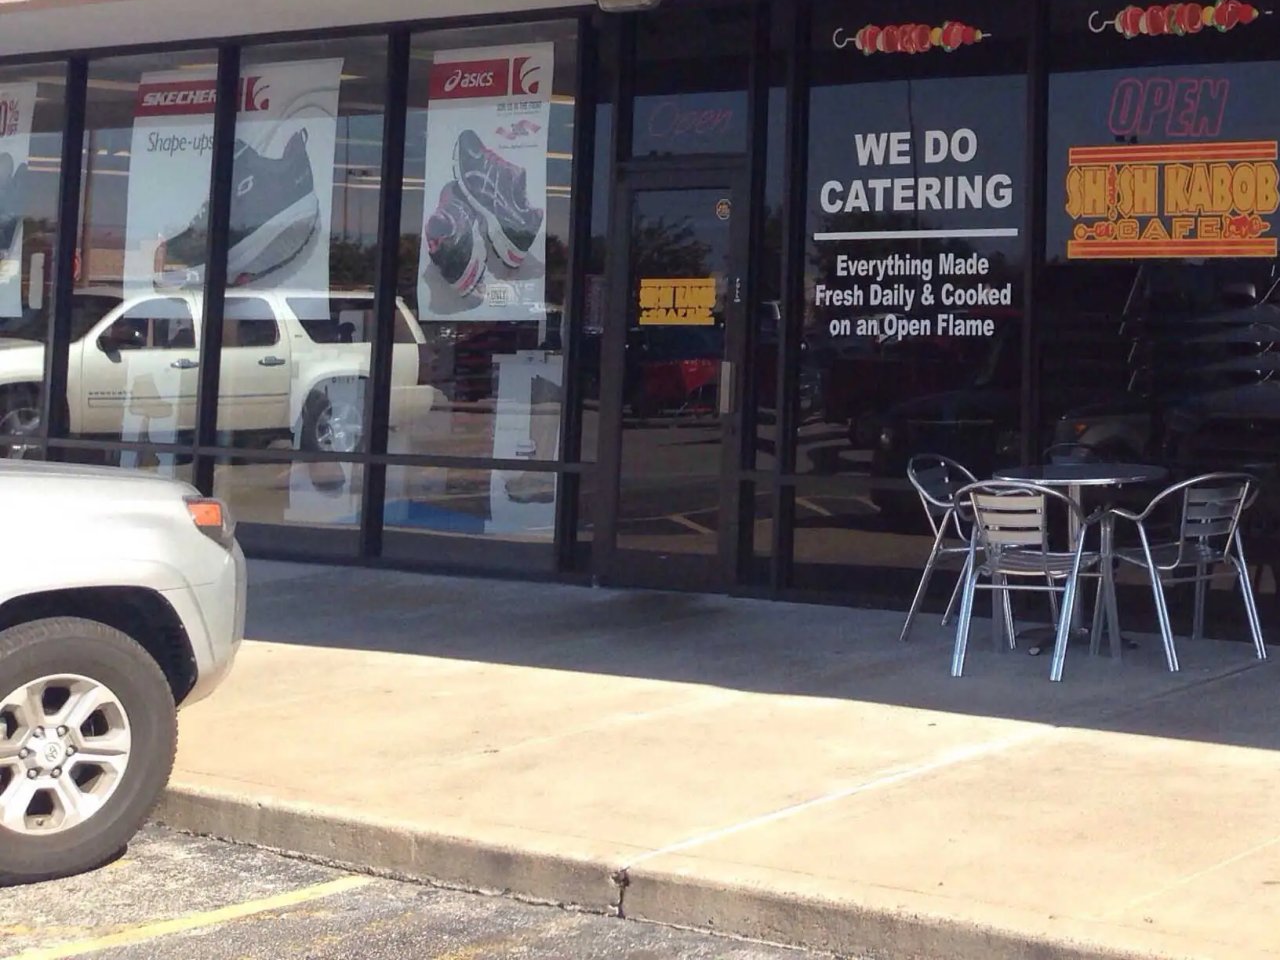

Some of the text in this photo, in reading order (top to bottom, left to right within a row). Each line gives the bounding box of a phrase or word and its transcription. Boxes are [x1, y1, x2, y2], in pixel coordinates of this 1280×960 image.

[141, 88, 217, 107] SKECHER
[1108, 77, 1230, 138] OPEN
[854, 128, 978, 167] WE DO
[820, 174, 1013, 214] CATERING
[1066, 162, 1280, 221] SHISH KABOB
[1117, 217, 1222, 240] CAFE
[836, 253, 990, 281] Everything Made
[815, 283, 1012, 311] Fresh Daily & Cooked
[829, 314, 995, 341] on an Open Flame
